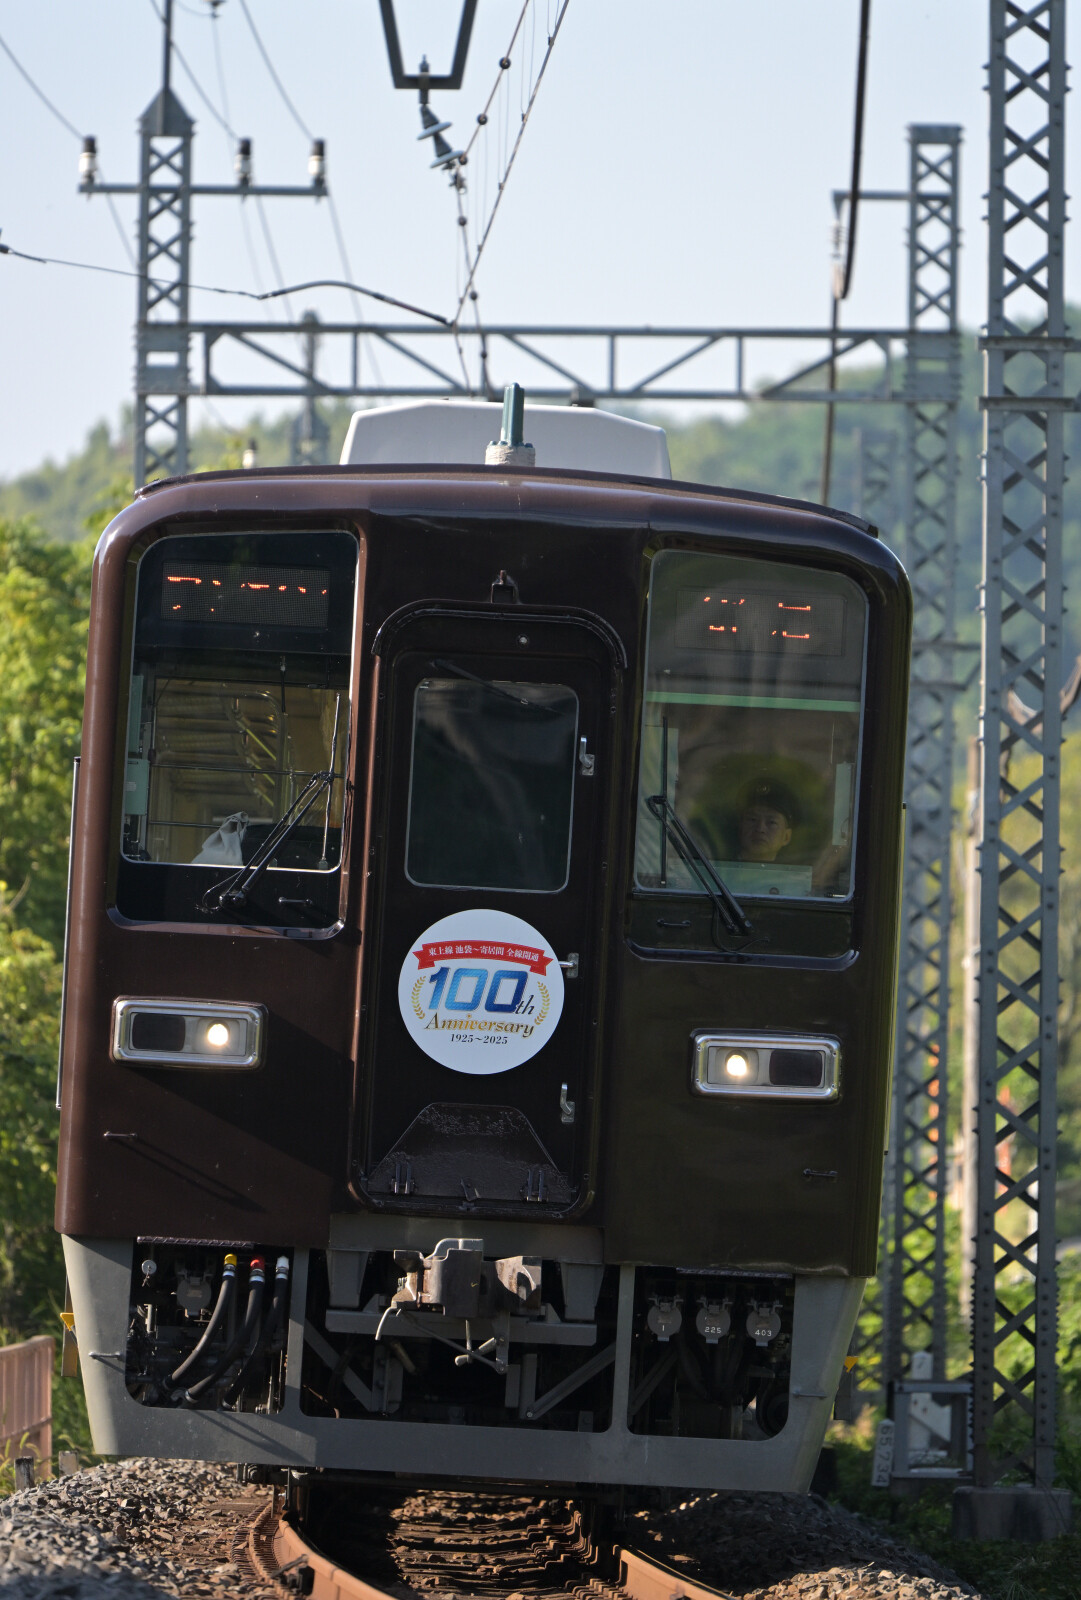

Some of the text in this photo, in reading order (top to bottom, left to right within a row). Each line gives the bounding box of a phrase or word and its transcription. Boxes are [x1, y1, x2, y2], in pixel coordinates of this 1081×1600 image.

[428, 945, 454, 957] 東上線
[424, 1012, 535, 1039] Anniversary
[704, 1326, 722, 1334] 225
[754, 1329, 772, 1337] 403
